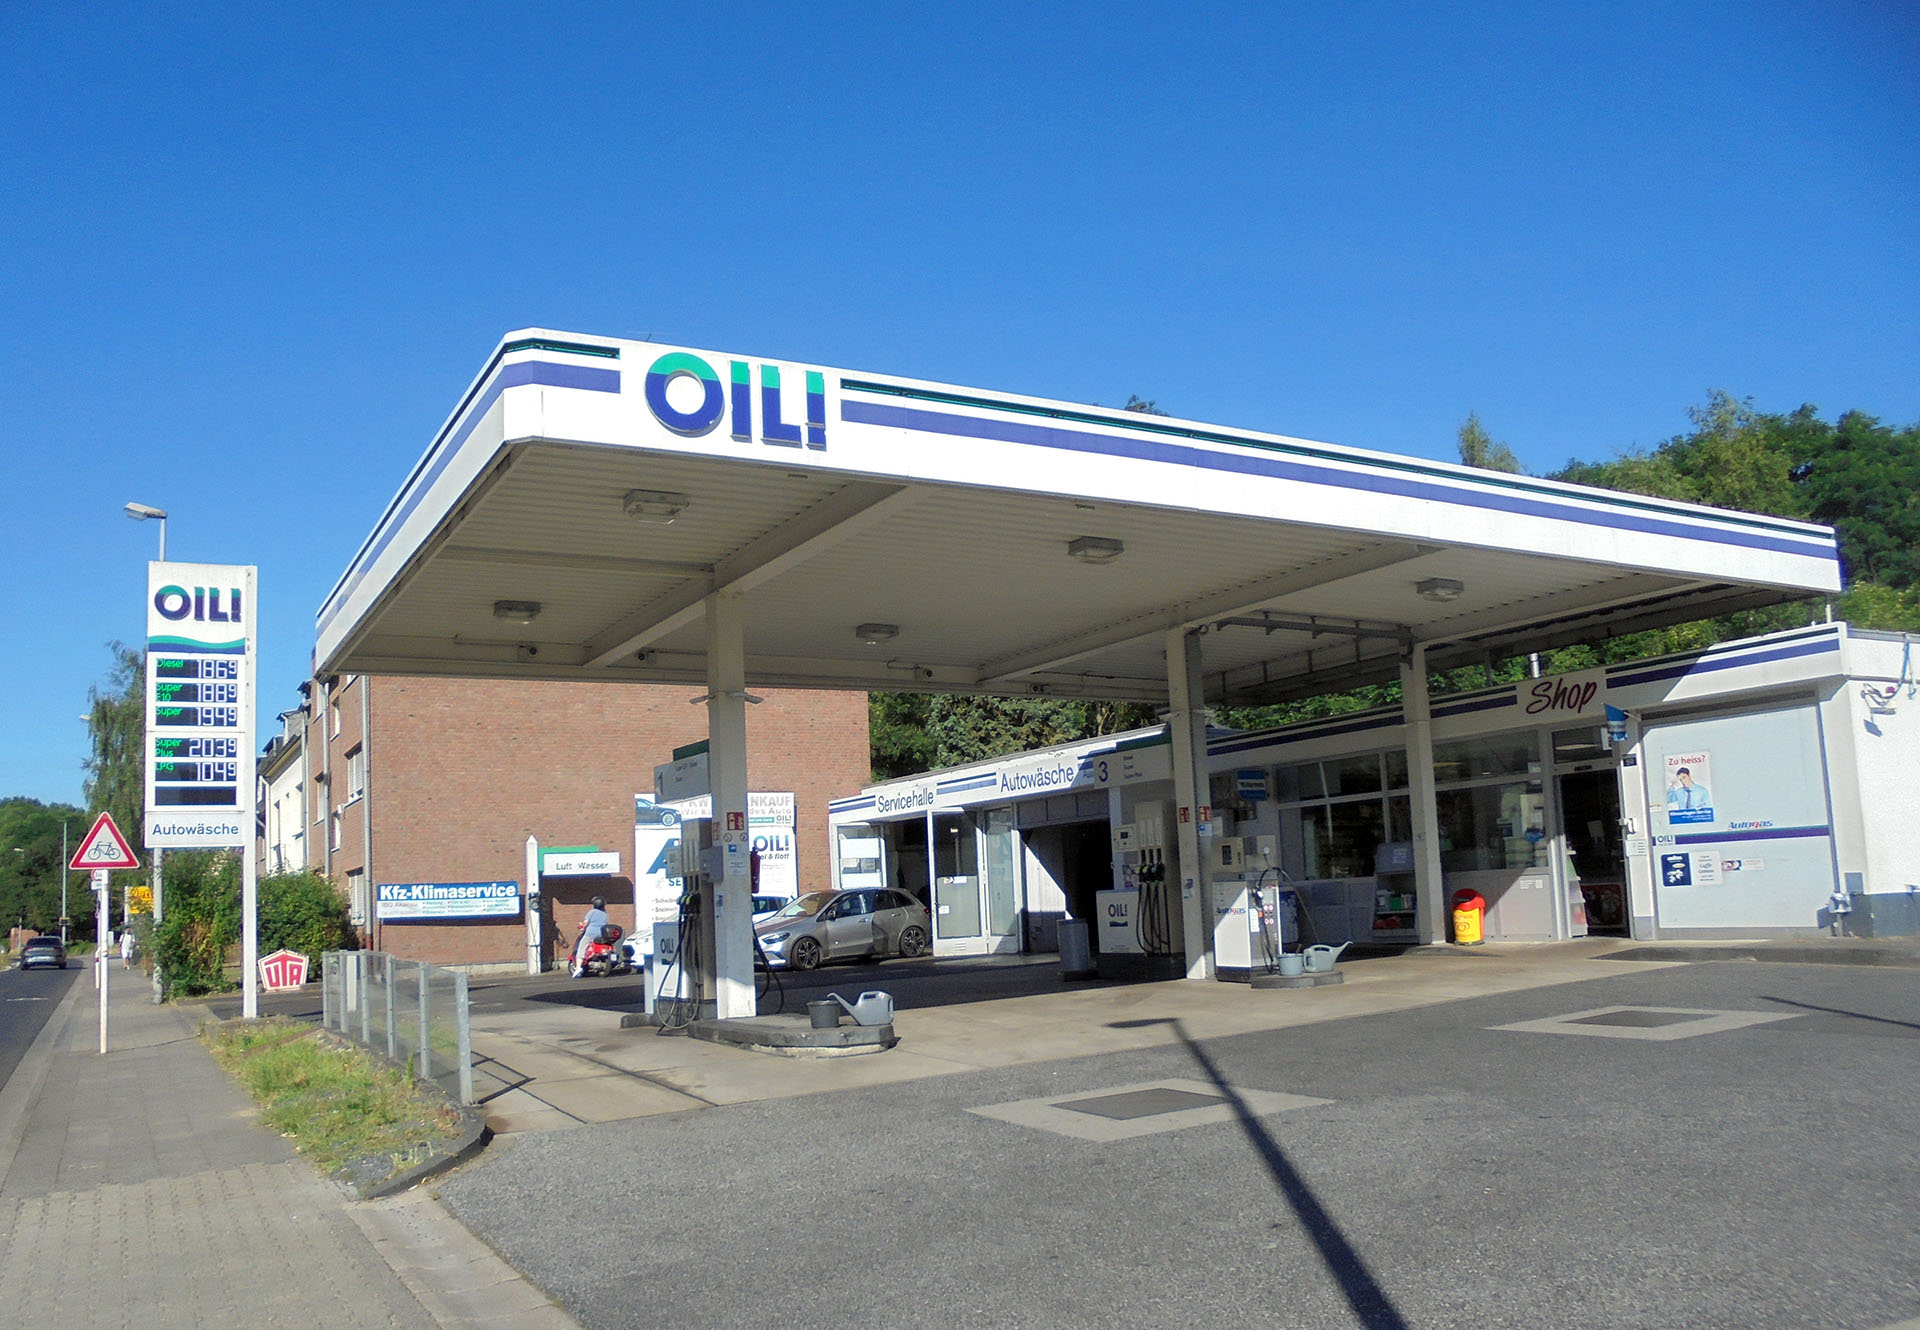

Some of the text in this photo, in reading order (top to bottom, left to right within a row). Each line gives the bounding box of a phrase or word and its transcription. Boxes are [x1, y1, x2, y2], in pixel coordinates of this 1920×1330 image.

[644, 352, 827, 452] OIL!
[154, 585, 241, 623] OIL!
[156, 658, 184, 668] Diesel
[156, 683, 182, 693] Super
[1526, 678, 1597, 714] Shop
[156, 707, 182, 717] Super
[155, 738, 182, 747] Super
[155, 748, 174, 757] Plus
[156, 762, 174, 771] LPG
[1668, 755, 1706, 766] Zu heiss?
[1000, 763, 1074, 793] Autowäsche
[1098, 760, 1108, 782] 3
[878, 787, 934, 813] Servicehalle
[152, 823, 239, 835] Autowäsche
[1728, 820, 1773, 829] Autogas
[753, 834, 790, 852] OIL!
[380, 882, 517, 900] Kfz-Klimaservice
[1107, 904, 1128, 918] OIL!
[264, 954, 304, 987] UTA
